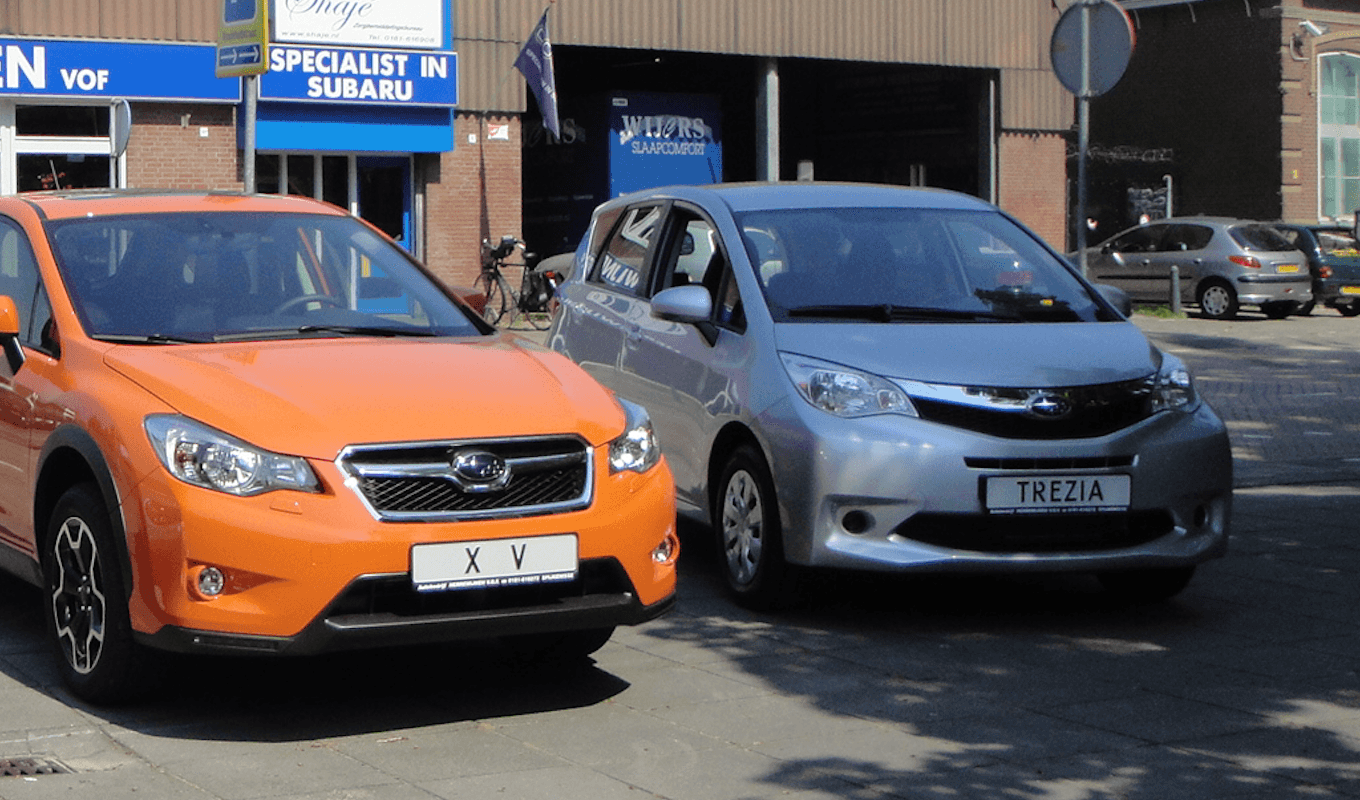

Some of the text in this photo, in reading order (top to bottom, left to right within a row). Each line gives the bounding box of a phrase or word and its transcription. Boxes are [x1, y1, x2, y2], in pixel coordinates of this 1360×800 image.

[270, 48, 448, 79] SPECIALIST IN
[60, 69, 109, 90] VOF
[307, 76, 413, 101] SUBARU
[631, 141, 707, 155] SLAAPCOMFORT
[1016, 479, 1104, 503] TREZIA
